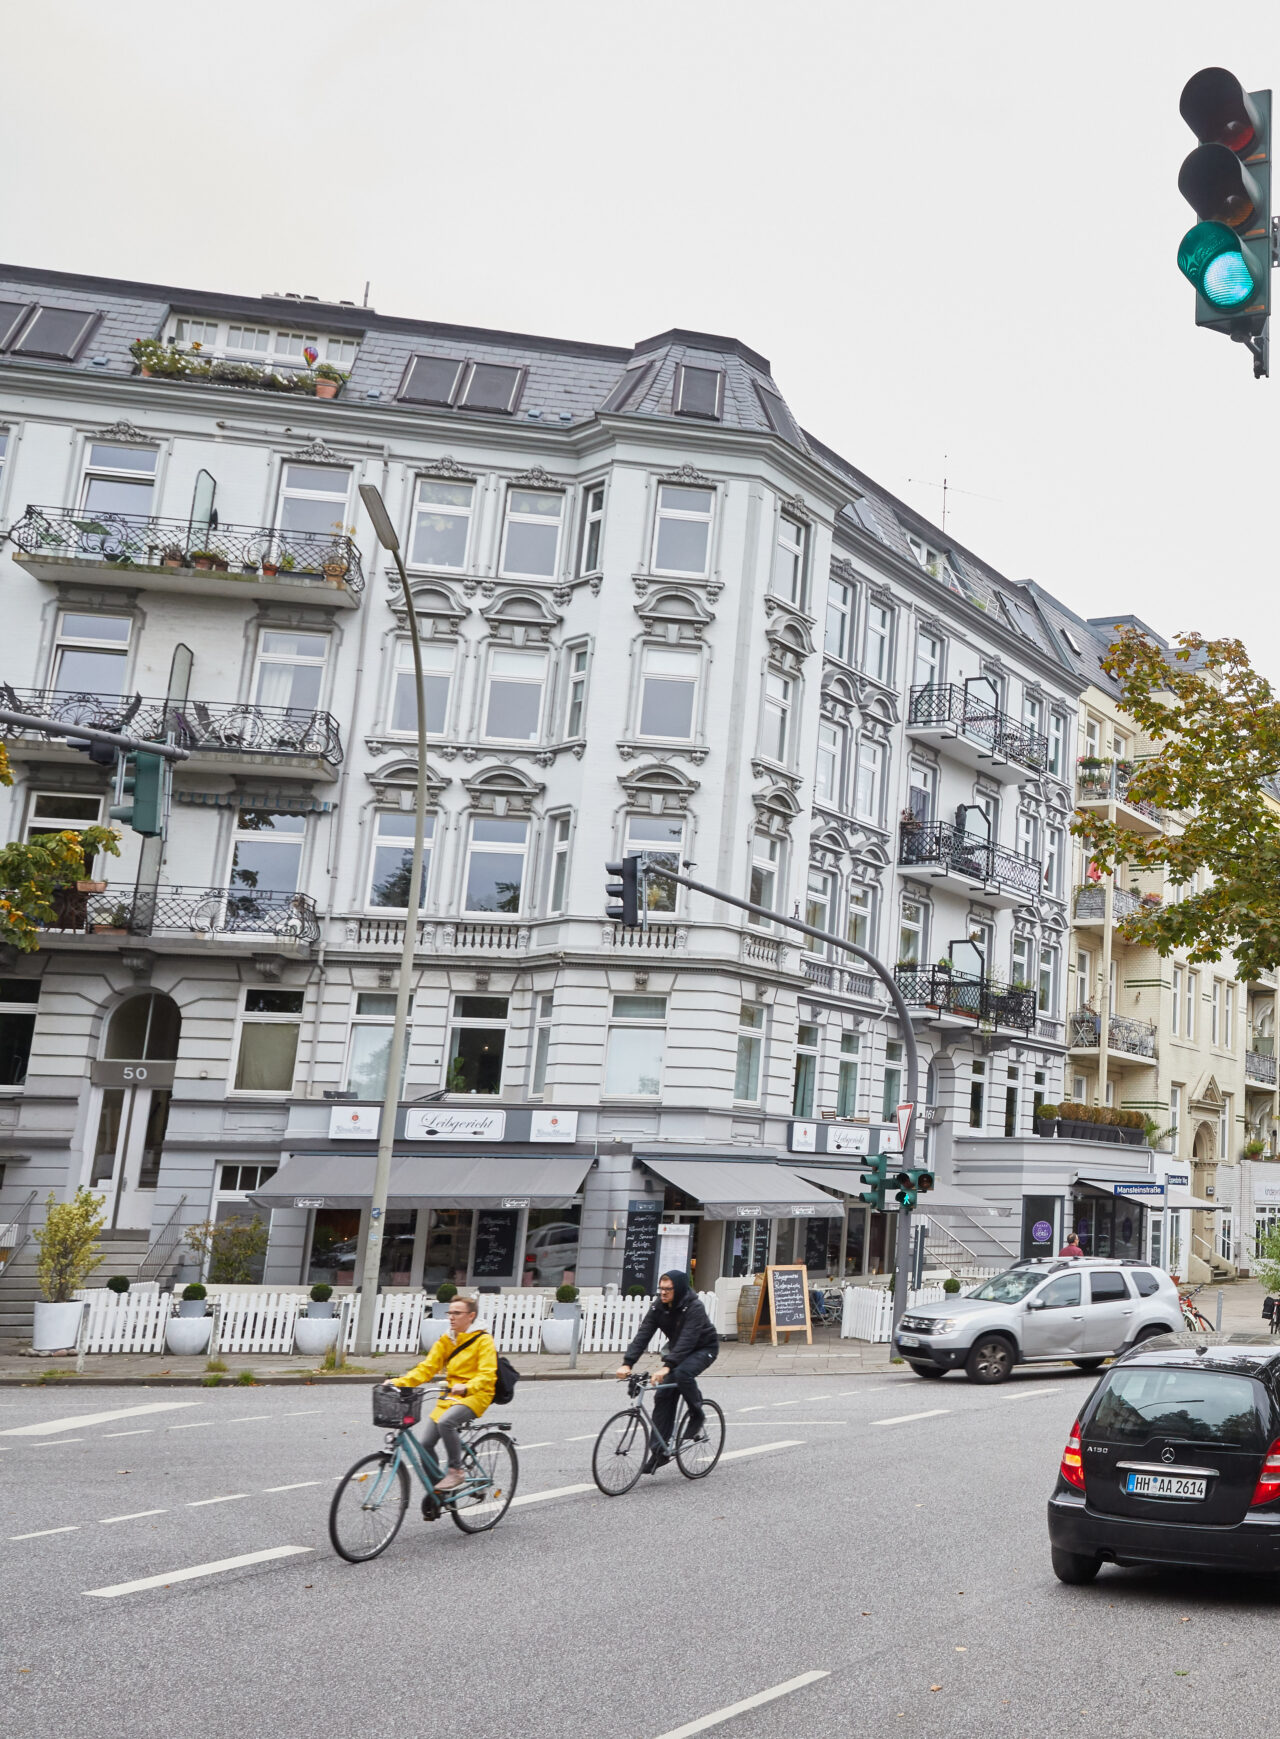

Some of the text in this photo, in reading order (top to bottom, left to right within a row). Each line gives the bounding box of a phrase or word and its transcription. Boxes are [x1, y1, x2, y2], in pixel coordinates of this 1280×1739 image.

[123, 1067, 147, 1080] 50
[418, 1112, 494, 1134] Leibgericht
[1117, 1186, 1162, 1194] Mansteinstraße
[1135, 1477, 1204, 1496] HH AA 2614
